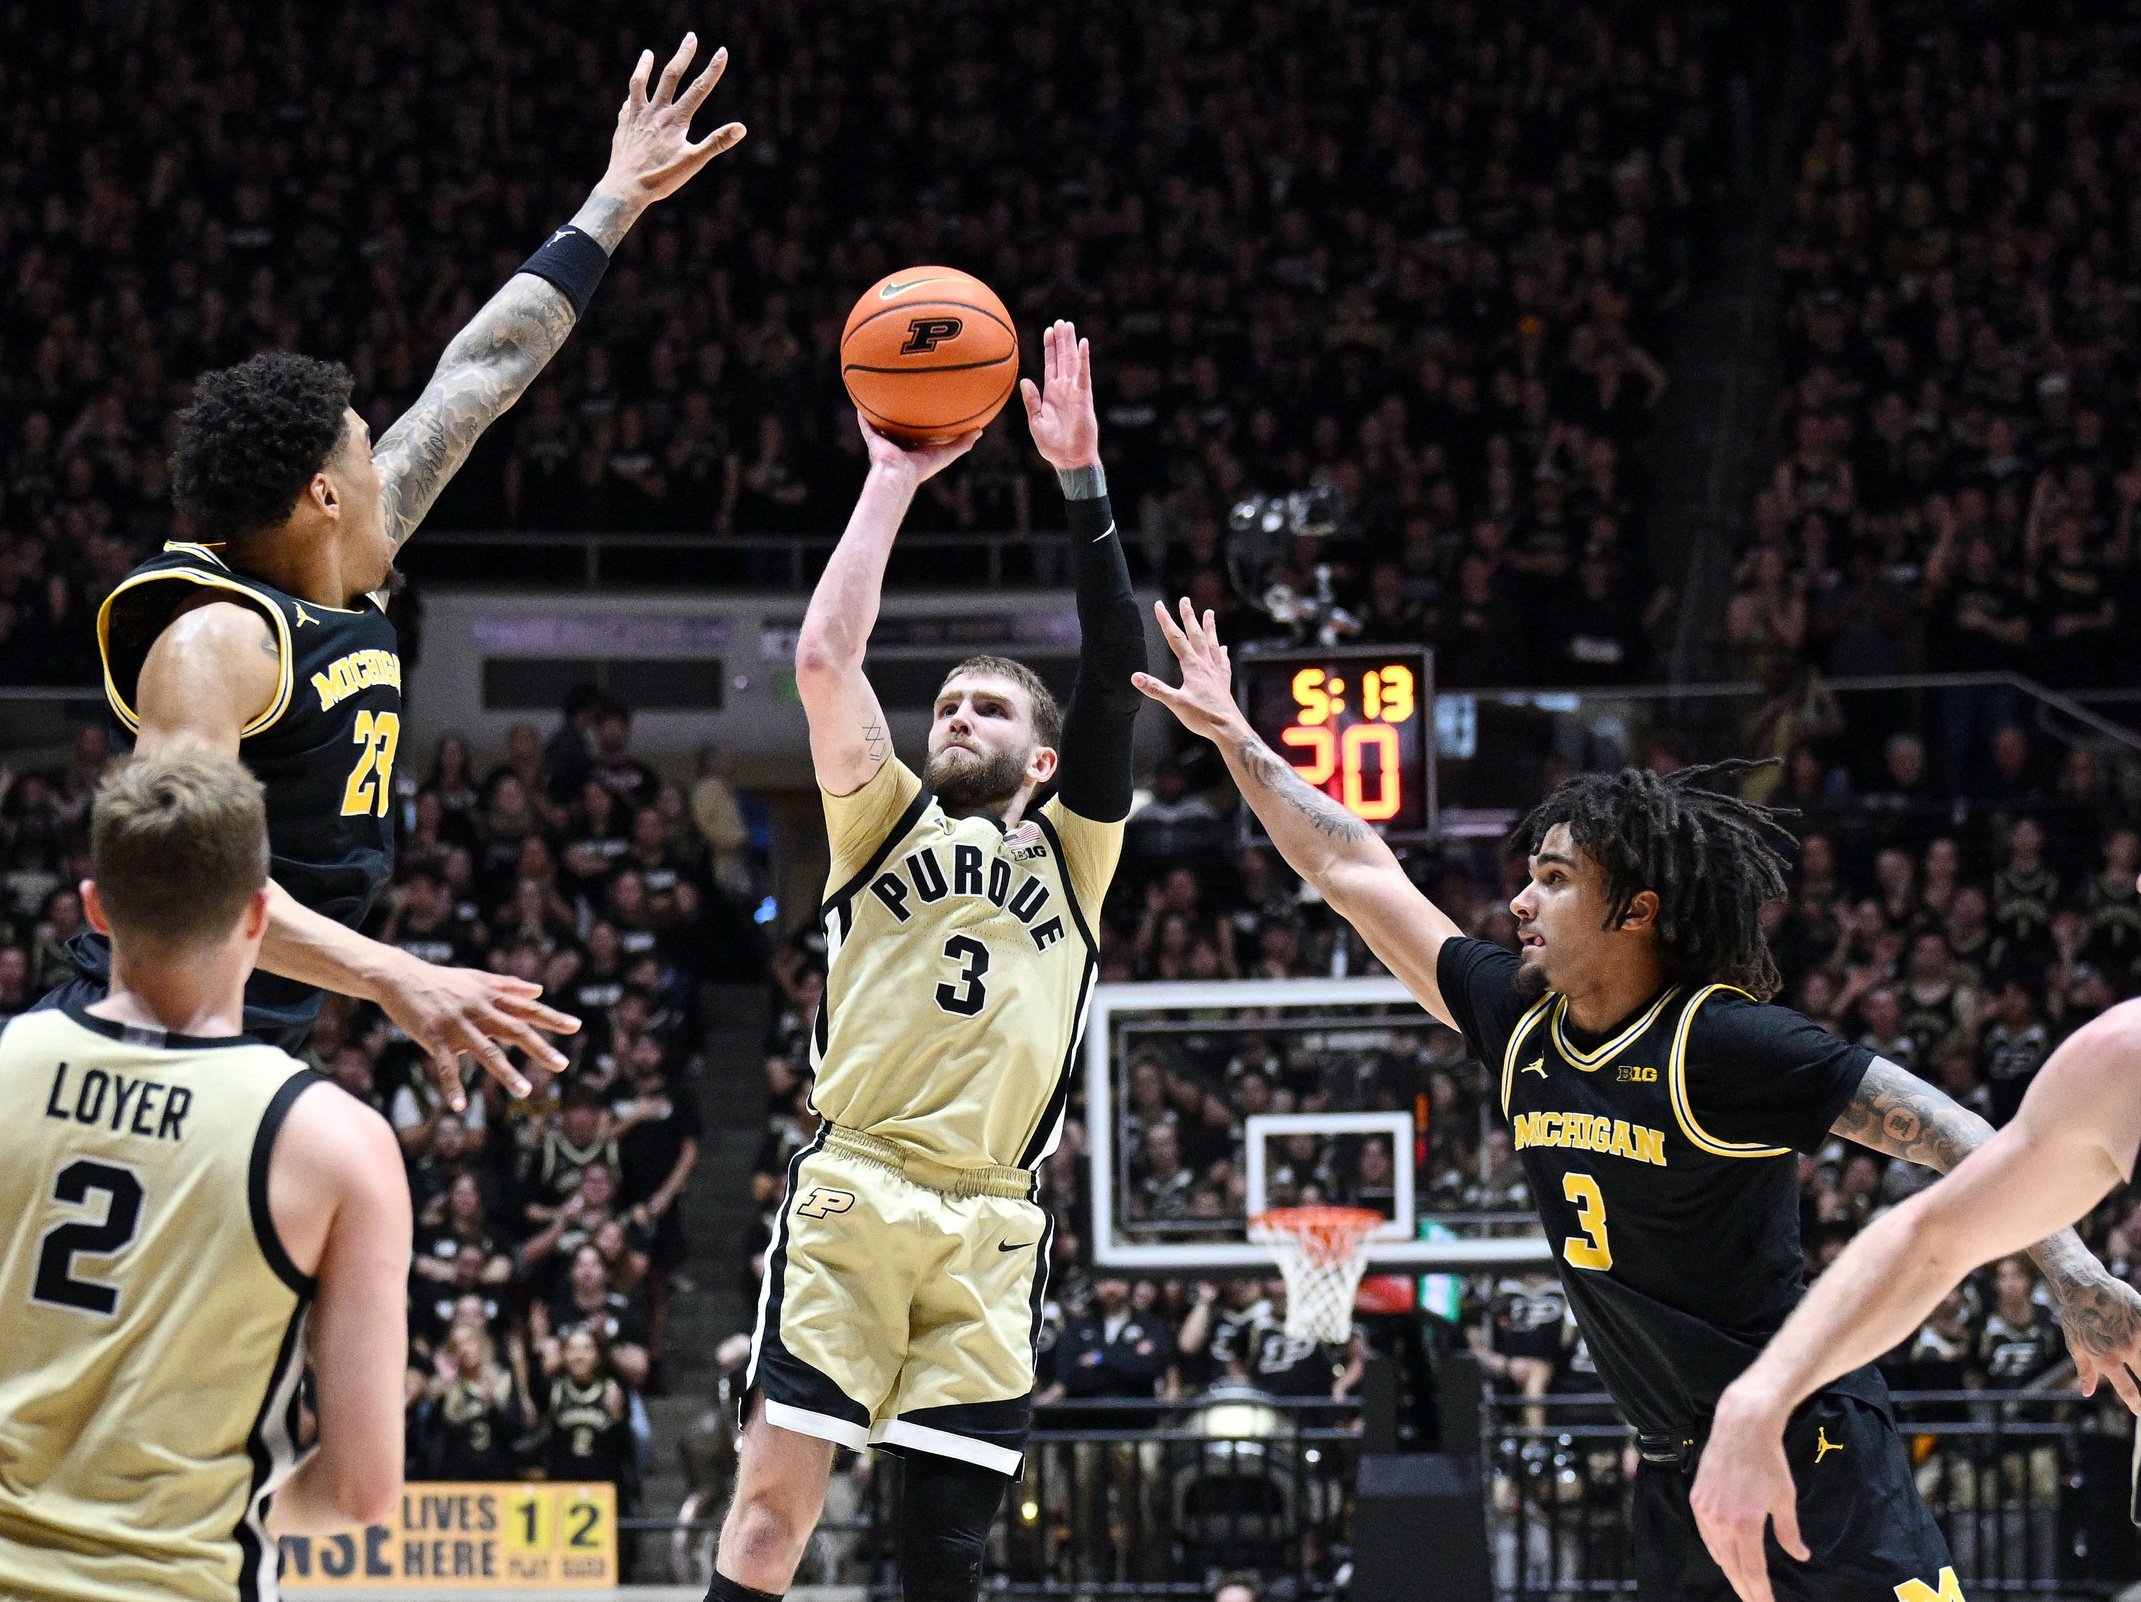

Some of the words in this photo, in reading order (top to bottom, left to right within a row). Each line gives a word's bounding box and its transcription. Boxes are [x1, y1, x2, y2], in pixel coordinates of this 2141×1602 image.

[901, 317, 963, 355] P
[1292, 665, 1414, 726] 5:13
[340, 709, 400, 818] 23
[869, 843, 1066, 954] PURDUE
[933, 933, 991, 1019] 3
[46, 1062, 193, 1141] LOYER
[1513, 1111, 1668, 1167] MICHIGAN
[797, 1187, 855, 1219] P
[1562, 1172, 1614, 1272] 3
[29, 1155, 146, 1321] 2
[402, 1495, 497, 1532] LIVES
[515, 1500, 538, 1545] 1
[567, 1503, 600, 1548] 2
[402, 1540, 497, 1577] HERE
